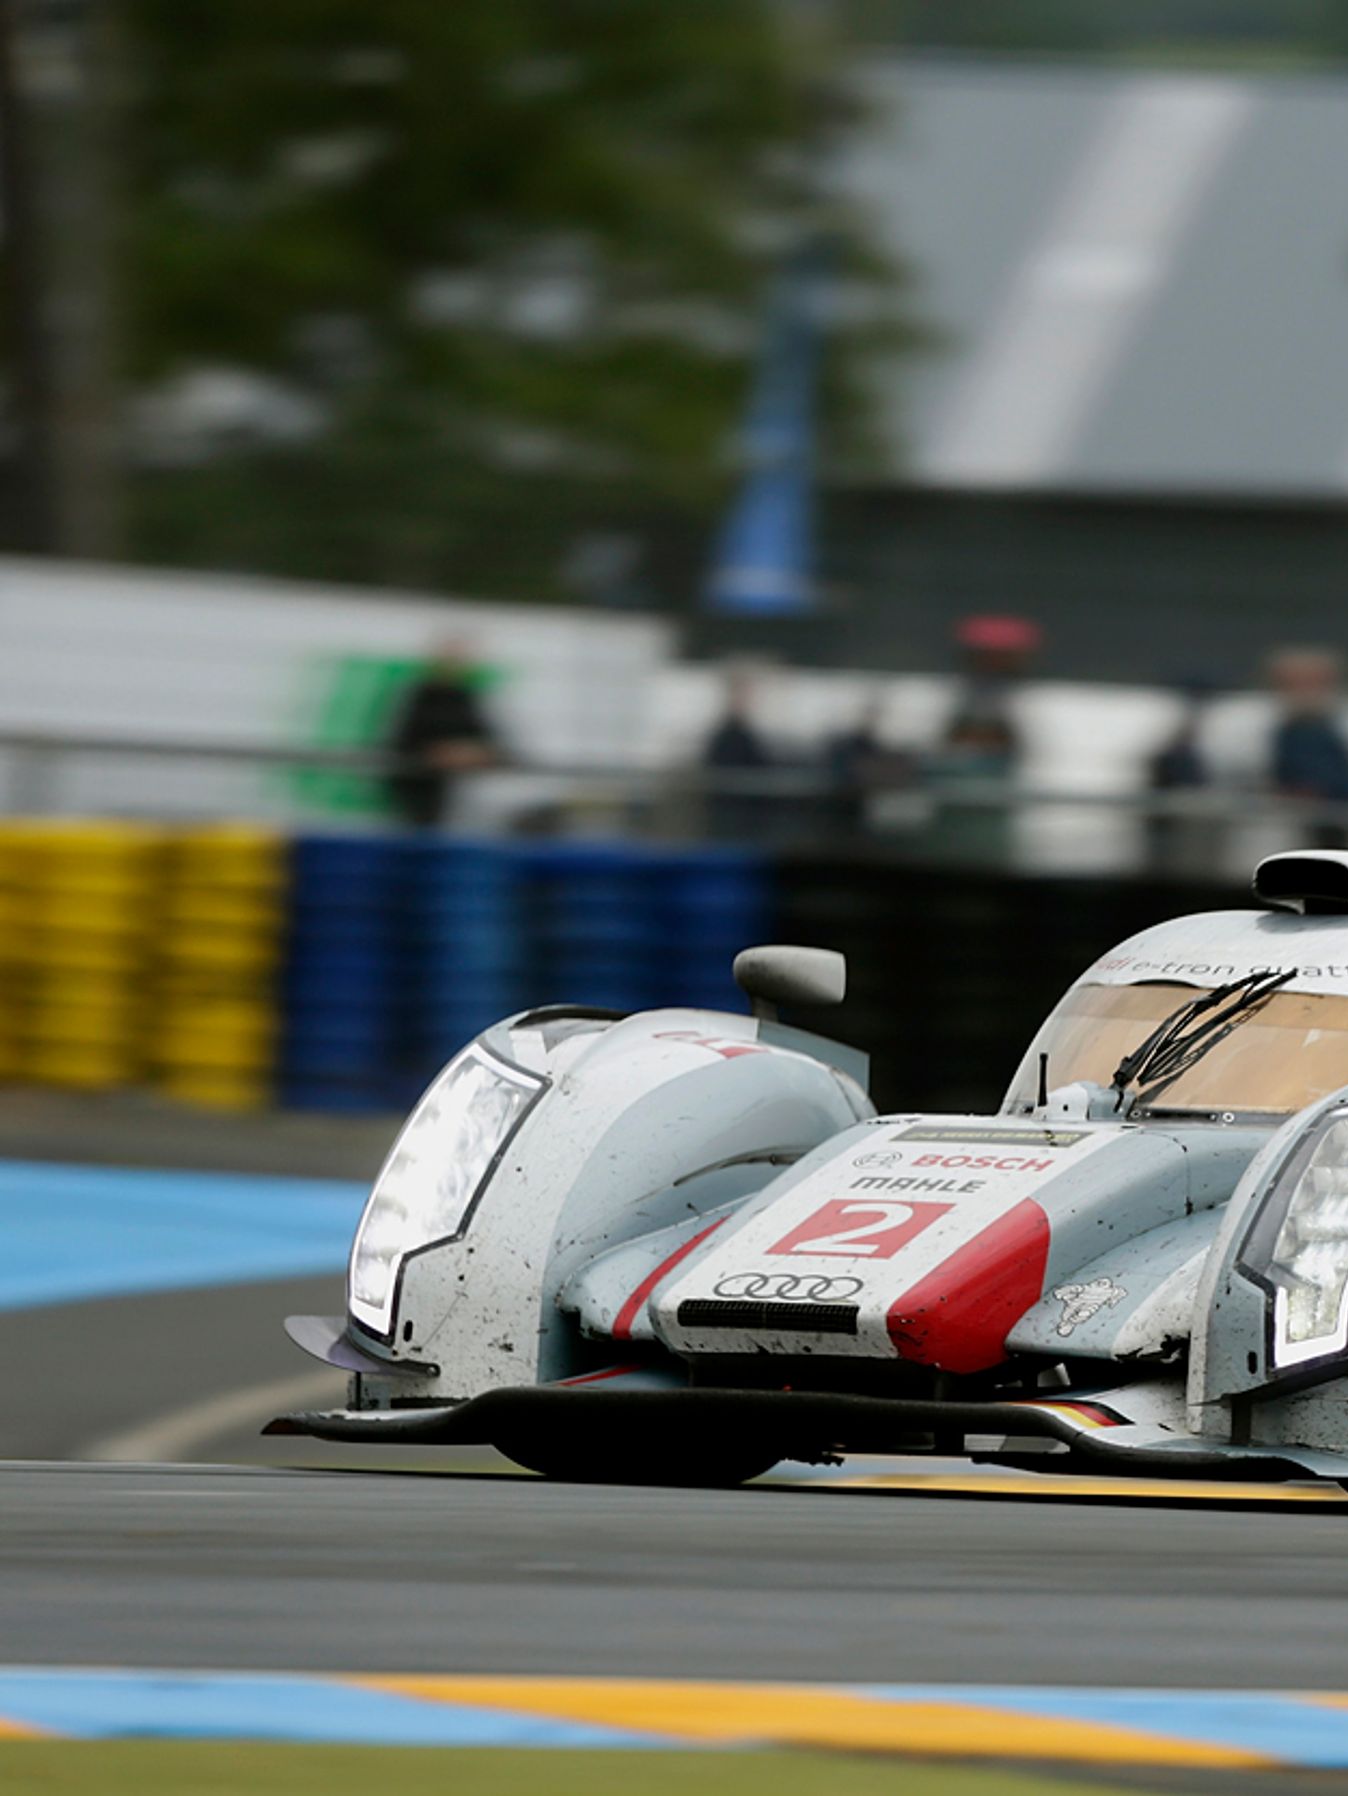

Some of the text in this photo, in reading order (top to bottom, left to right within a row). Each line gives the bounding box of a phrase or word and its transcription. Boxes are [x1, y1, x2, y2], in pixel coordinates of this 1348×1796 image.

[1132, 960, 1235, 976] e-tron
[911, 1154, 1055, 1172] BOSCH
[849, 1176, 986, 1194] MAHLE
[791, 1203, 914, 1255] 2
